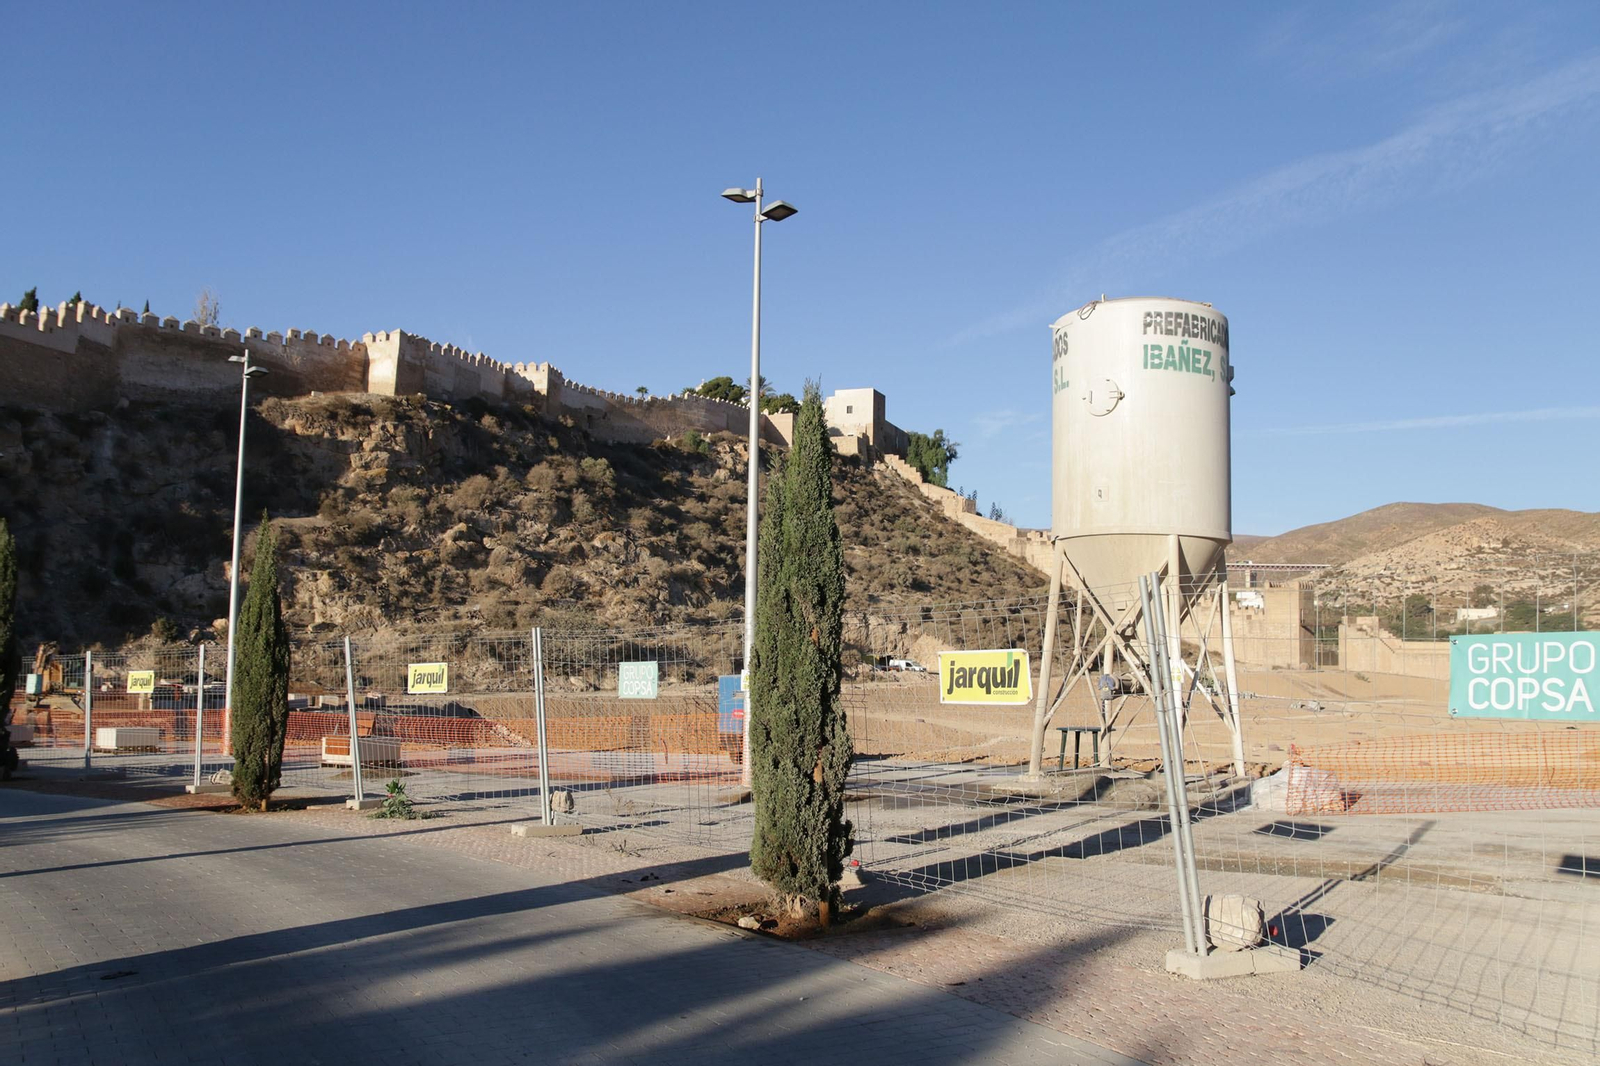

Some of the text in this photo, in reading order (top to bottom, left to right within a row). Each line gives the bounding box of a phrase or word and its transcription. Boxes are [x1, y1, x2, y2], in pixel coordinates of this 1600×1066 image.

[1054, 366, 1070, 394] S.L.
[1468, 641, 1596, 674] GRUPO
[411, 668, 445, 688] jarquil
[623, 665, 654, 680] GRUPO
[947, 659, 1021, 695] jarquil
[622, 680, 653, 696] COPSA
[1468, 677, 1595, 713] COPSA
